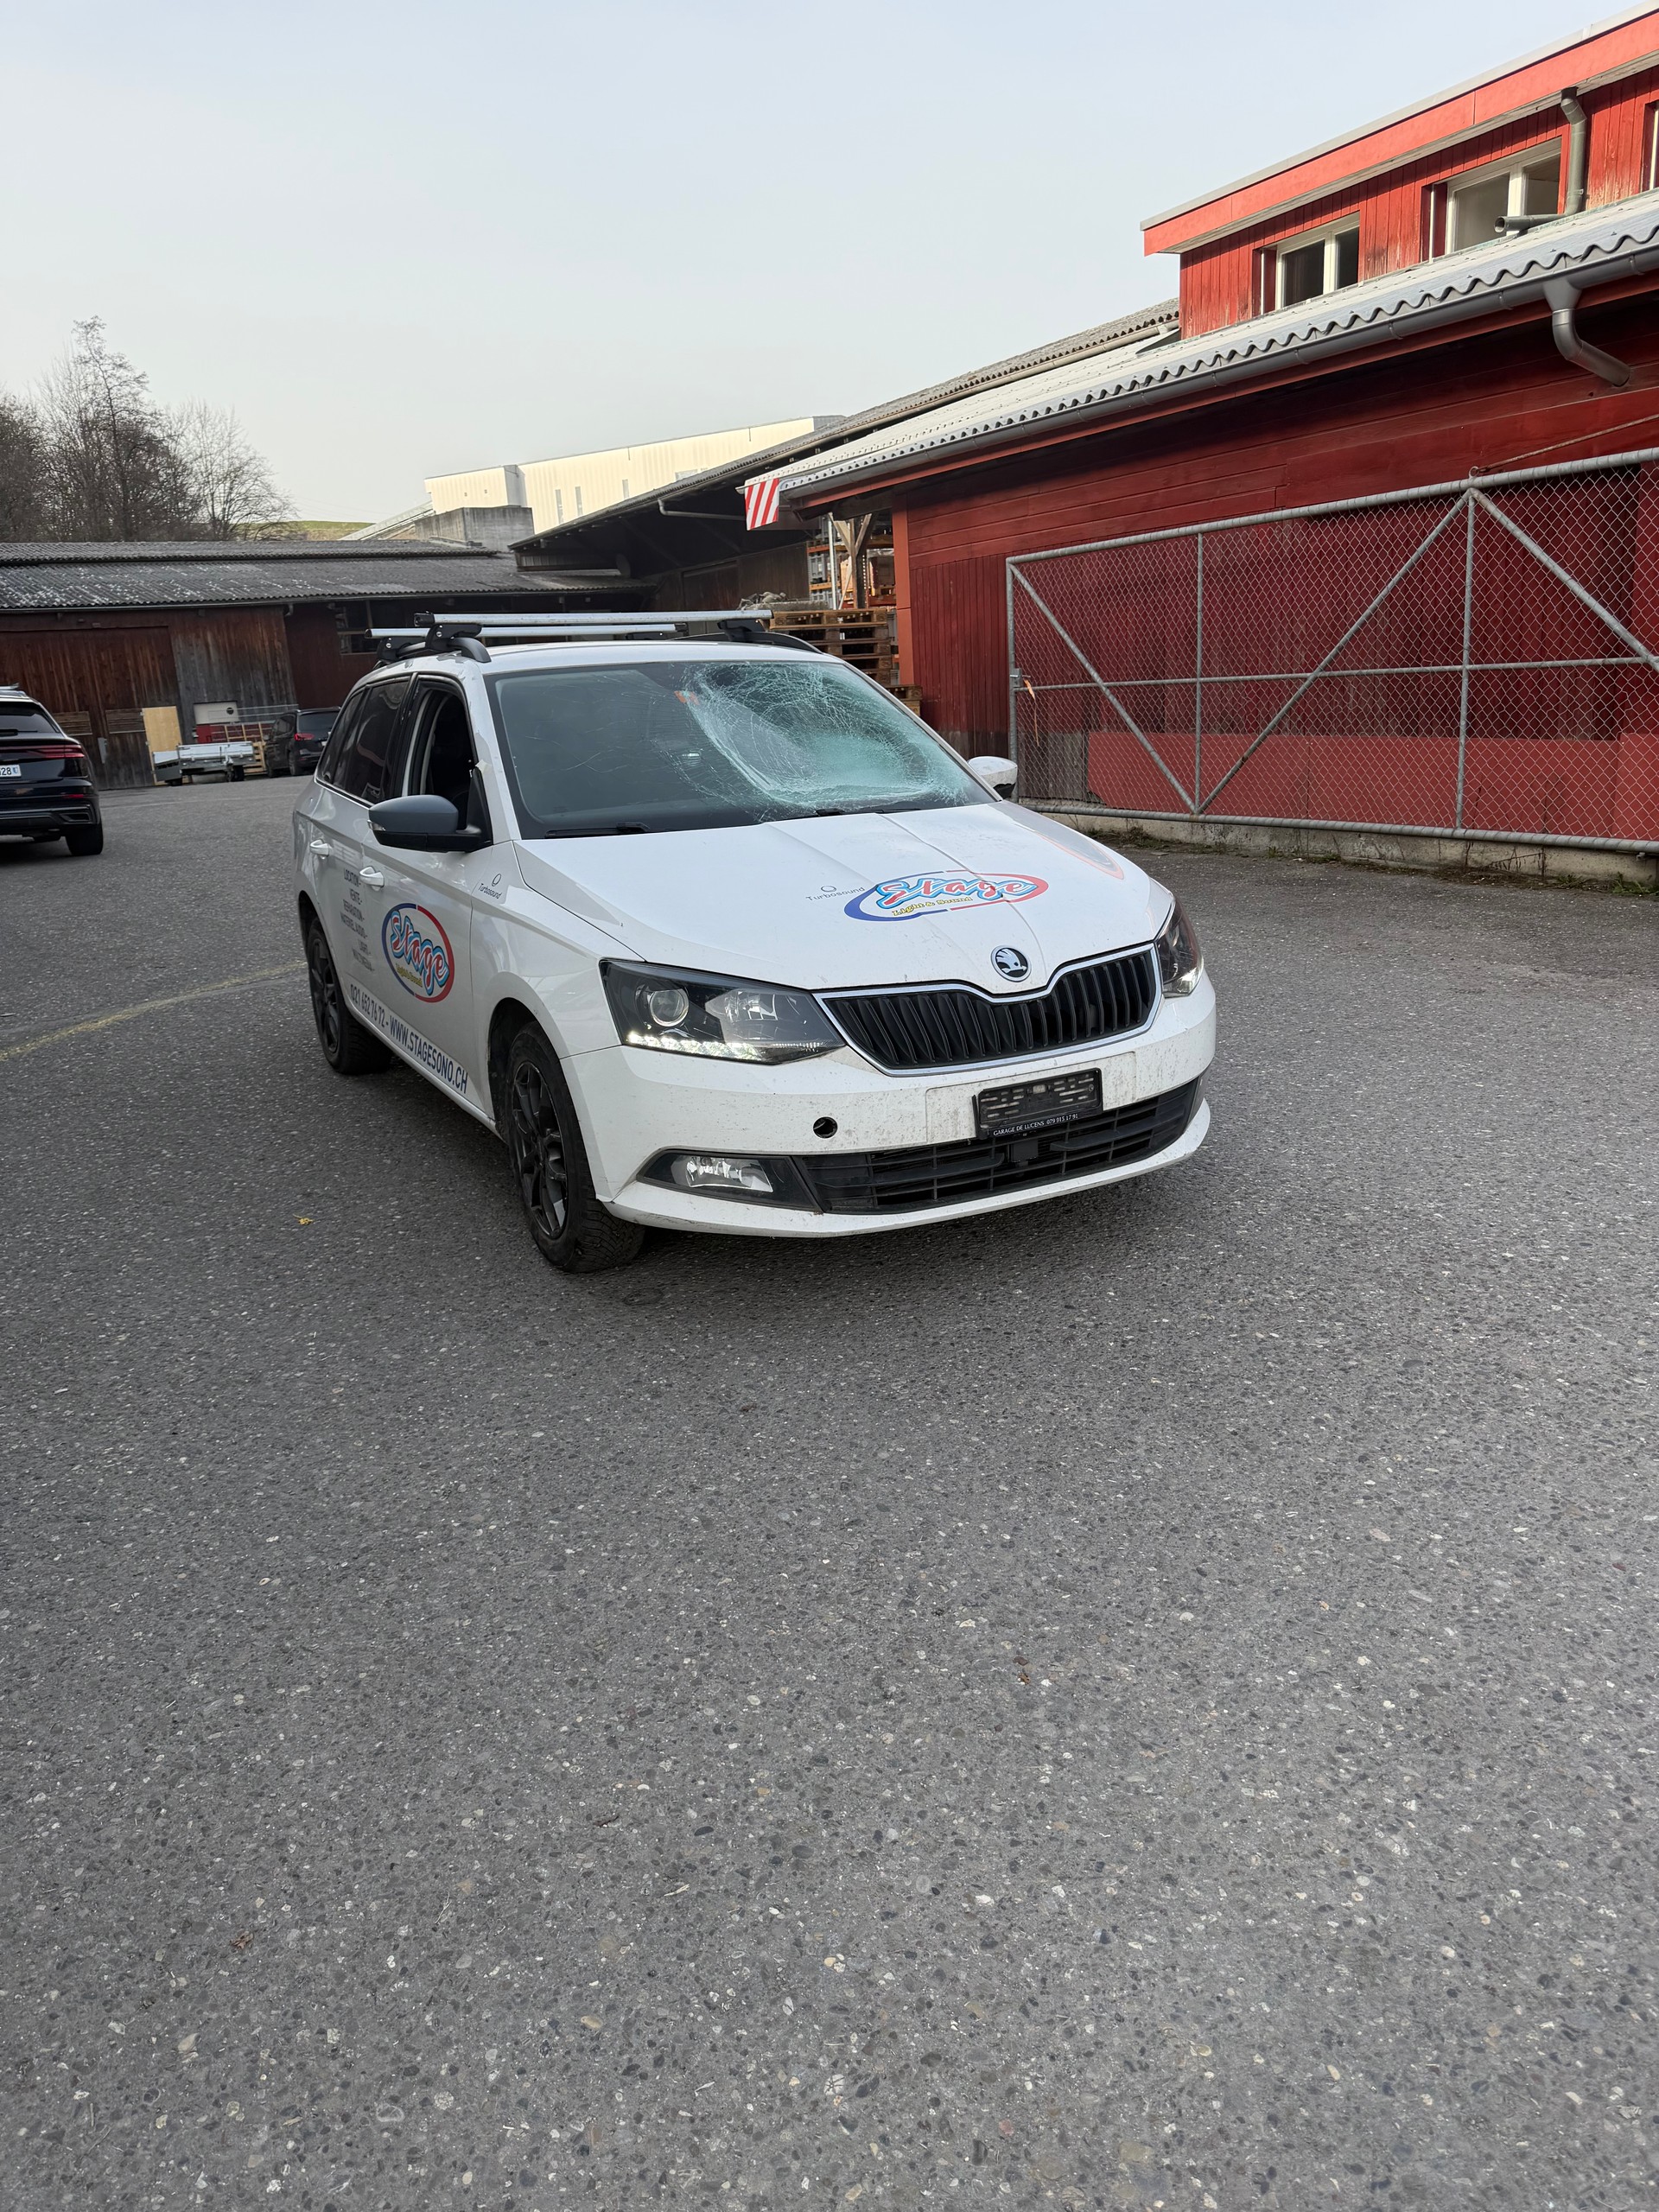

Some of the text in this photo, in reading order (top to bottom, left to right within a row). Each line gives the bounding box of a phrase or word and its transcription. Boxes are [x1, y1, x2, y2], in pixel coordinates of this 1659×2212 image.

[0, 766, 12, 776] 28
[478, 882, 503, 899] Turbosound
[805, 887, 866, 901] Turbosound
[875, 877, 1038, 909] Stage
[892, 901, 925, 916] Light
[937, 896, 974, 905] Sound
[390, 909, 450, 995] Stage
[350, 983, 360, 1006] 021
[371, 1000, 378, 1021] 76
[378, 1006, 385, 1028] 72
[390, 1015, 468, 1094] WWW.STAGESONO.CH
[993, 1126, 1015, 1136] GARAGE
[1024, 1121, 1045, 1129] LUCENS
